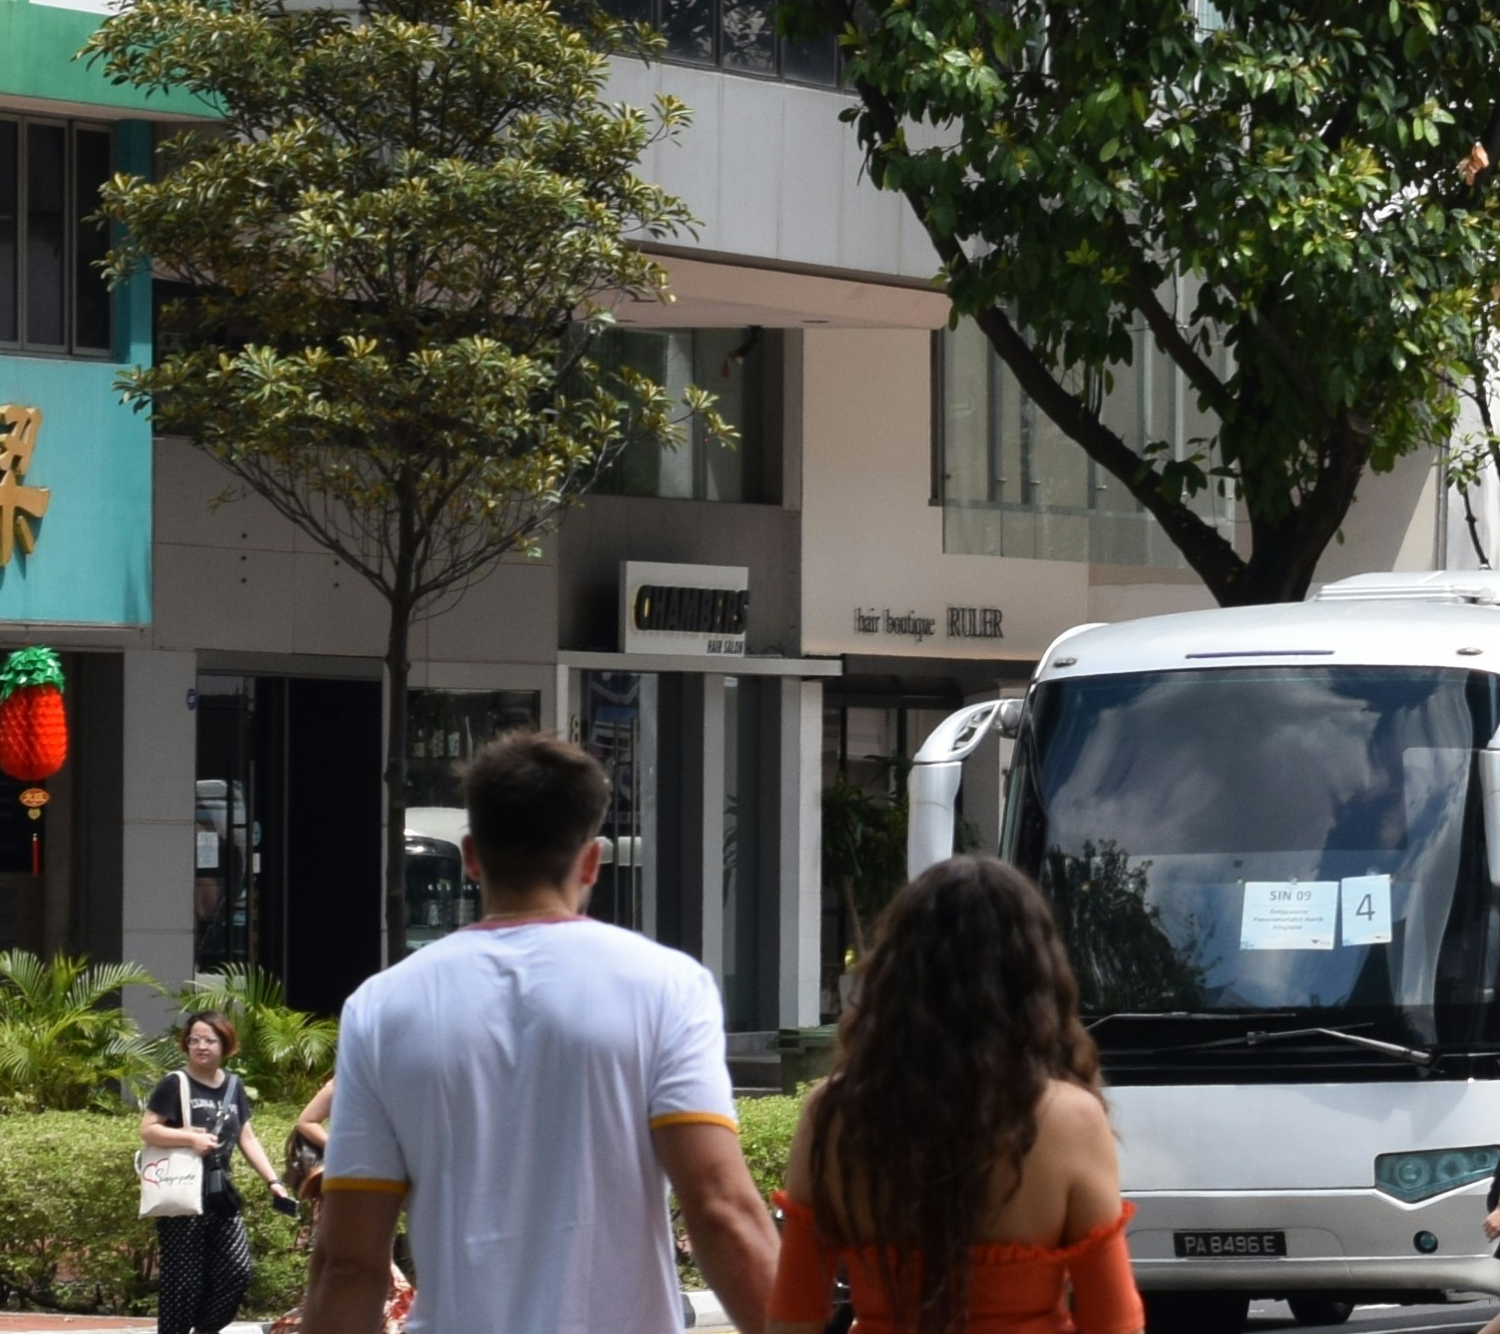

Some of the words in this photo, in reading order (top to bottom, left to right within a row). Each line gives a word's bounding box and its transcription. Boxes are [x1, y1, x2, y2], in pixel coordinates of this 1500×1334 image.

[633, 584, 749, 635] CHAMBERS
[854, 607, 881, 634] hair
[946, 607, 1004, 638] RULER
[1269, 890, 1292, 902] SIN
[1296, 890, 1312, 901] 09
[1355, 893, 1376, 921] 4
